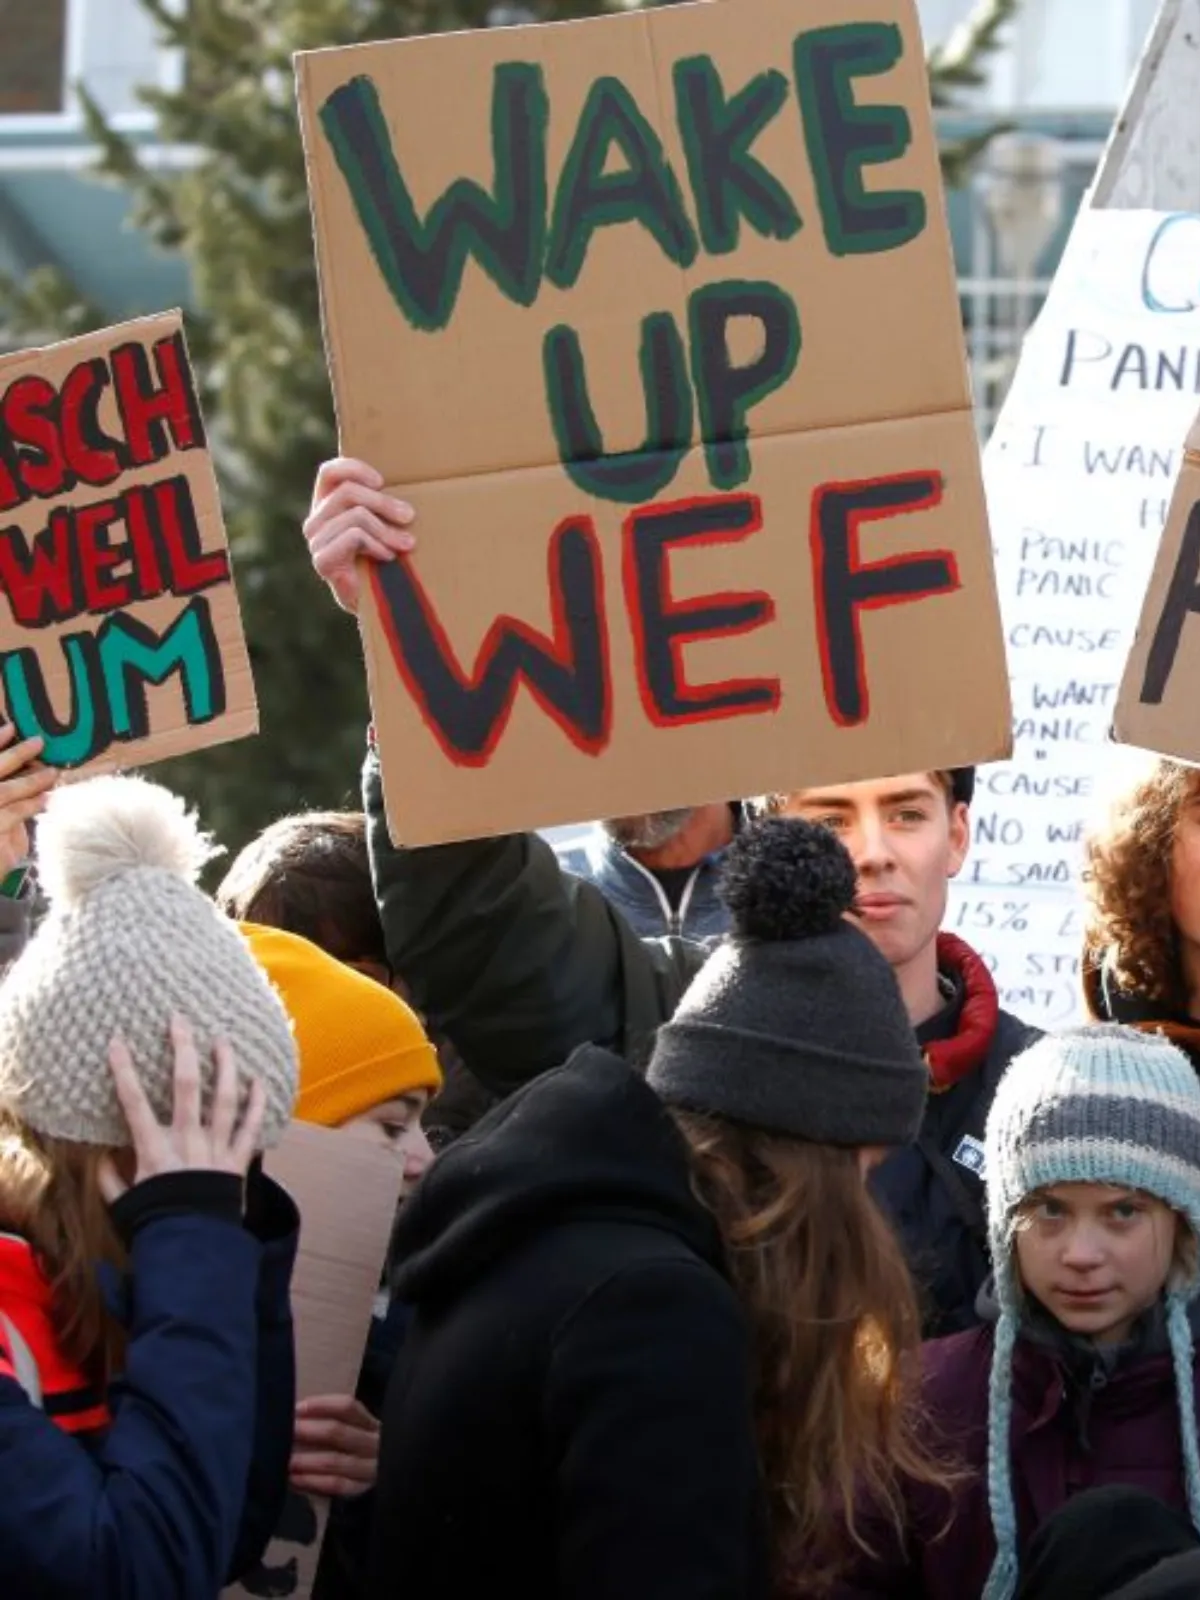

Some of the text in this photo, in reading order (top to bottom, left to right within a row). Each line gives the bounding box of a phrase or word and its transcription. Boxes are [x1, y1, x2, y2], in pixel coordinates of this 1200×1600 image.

[318, 22, 926, 332] WAKE
[542, 279, 802, 502] UP
[0, 330, 205, 508] SCH
[0, 474, 230, 629] WEIL
[1021, 526, 1125, 567] PANIC
[1016, 567, 1117, 598] PANIC
[370, 470, 962, 768] WEF
[1009, 623, 1121, 652] CAUSE
[1033, 680, 1116, 709] WANT
[1012, 718, 1092, 742] ANIC
[974, 811, 1024, 845] NO
[1007, 859, 1070, 885] SAID
[955, 901, 1029, 931] 15%
